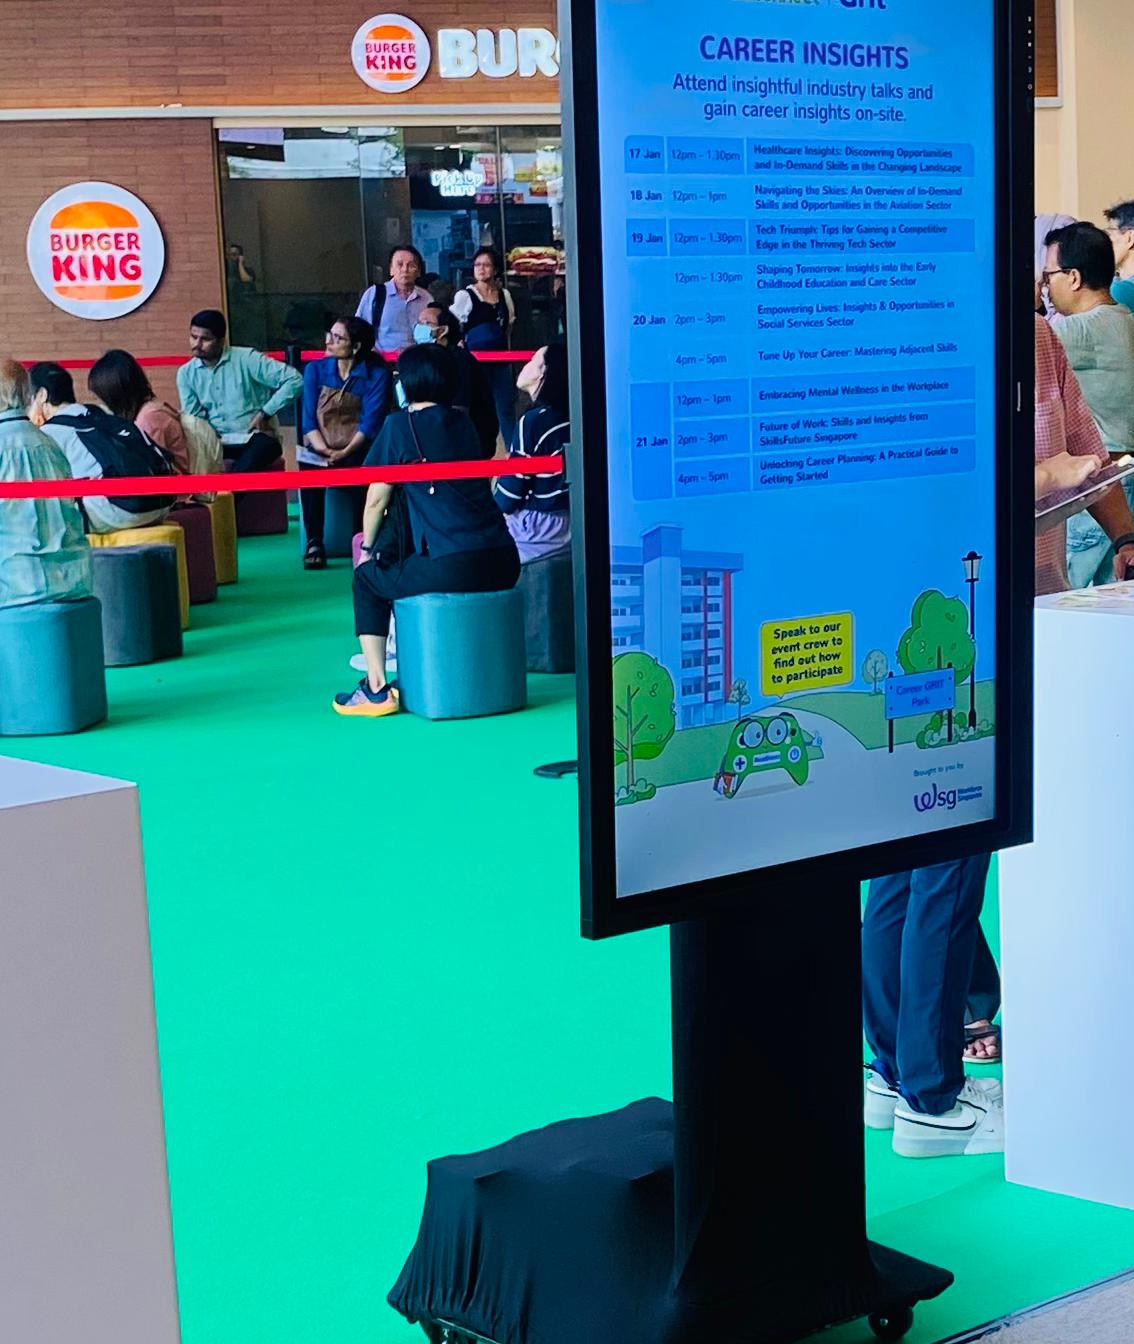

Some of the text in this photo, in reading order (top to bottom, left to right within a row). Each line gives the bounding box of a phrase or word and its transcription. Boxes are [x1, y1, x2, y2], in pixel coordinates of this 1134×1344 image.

[366, 42, 415, 53] BURGER
[438, 28, 560, 78] BUR
[700, 35, 909, 69] CAREER INSIGHTS
[367, 55, 416, 70] KING
[673, 73, 933, 101] Attend insightful industry talks and
[704, 100, 906, 124] gain career insights on-site.
[629, 149, 660, 159] 17 Jan
[672, 149, 696, 160] 12pm
[631, 190, 662, 201] 18 Jan
[673, 190, 727, 203] 12pm 1pm
[755, 185, 962, 197] Navigating the Skies: An Overview of In-Demand
[50, 233, 140, 251] BURGER
[632, 233, 663, 243] 19 Jan
[674, 233, 742, 244] 12pm 1.30pm
[756, 239, 896, 251] Edge in the Thriving Tech Sector
[52, 254, 142, 281] KING
[757, 262, 936, 276] Shaping Tomorrow: Insights into the Early
[675, 272, 743, 284] 12pm 1.30pm
[757, 277, 916, 289] Childhood Education and Care Sector
[758, 300, 954, 316] Empowering Lives: Insights & Opportunities in
[633, 315, 666, 325] 20 Jan
[675, 313, 725, 326] 2pm 3pm
[758, 317, 854, 329] Social Services Sector
[758, 342, 957, 362] Tune Up Your Career: Mastering Adjacent Skills
[676, 354, 727, 367] 4pm 5pm
[760, 381, 949, 400] Embracing Mental Wellness in the Workplace
[677, 394, 731, 406] 12pm 1pm
[760, 412, 928, 432] Future of Work: Skills and Insights from
[636, 436, 668, 447] 21 Jan
[677, 433, 728, 446] 2pm 3pm
[760, 432, 858, 446] SkillsFuture Singapore
[678, 472, 728, 485] 4pm 5pm
[760, 470, 828, 485] Getting Started
[774, 622, 840, 640] Speak to our
[772, 637, 842, 655] event crew to
[774, 651, 841, 669] find out how
[772, 665, 843, 684] to participate
[896, 679, 944, 695] Career GRIT
[912, 696, 930, 706] Park
